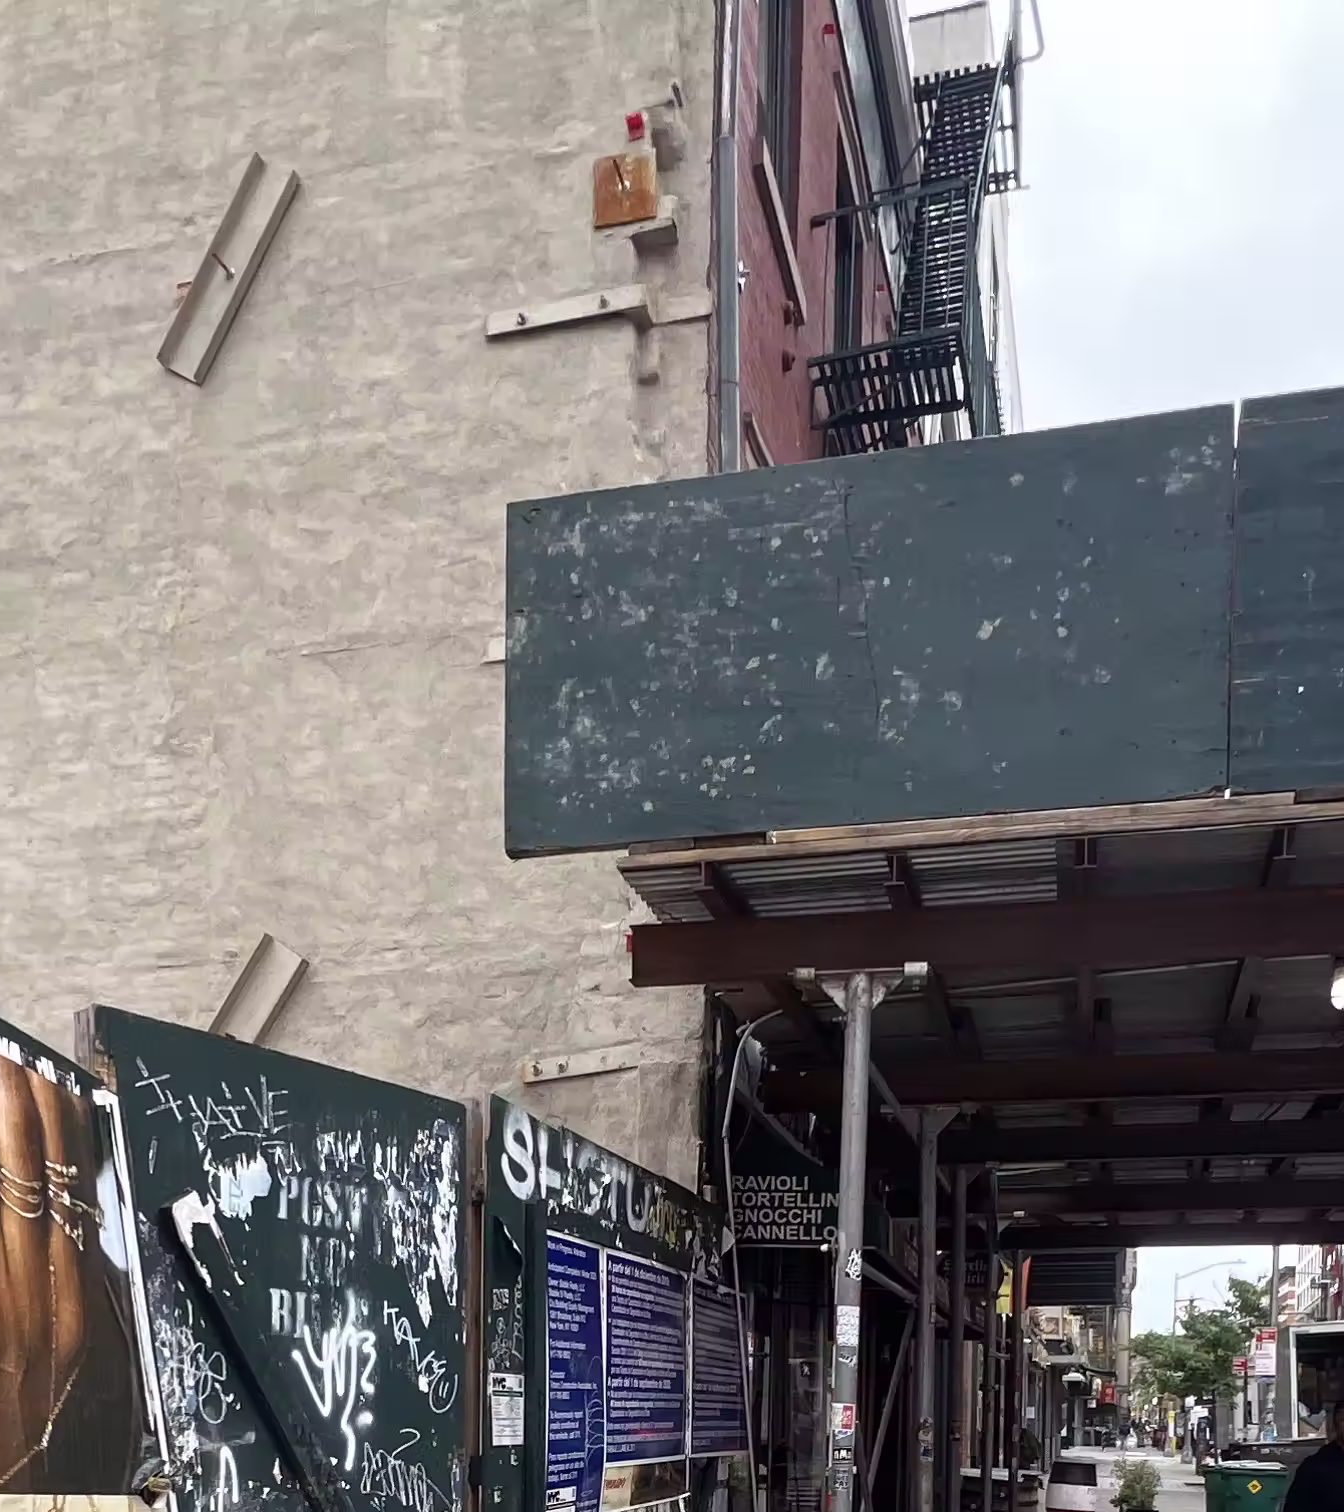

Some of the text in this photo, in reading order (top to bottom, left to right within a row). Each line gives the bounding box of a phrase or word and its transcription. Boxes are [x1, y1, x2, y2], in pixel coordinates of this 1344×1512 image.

[731, 1175, 809, 1191] RAVIOLI
[732, 1191, 840, 1208] TORTELLIN
[732, 1208, 823, 1225] GNOCCHI
[730, 1225, 839, 1241] CANNELLO
